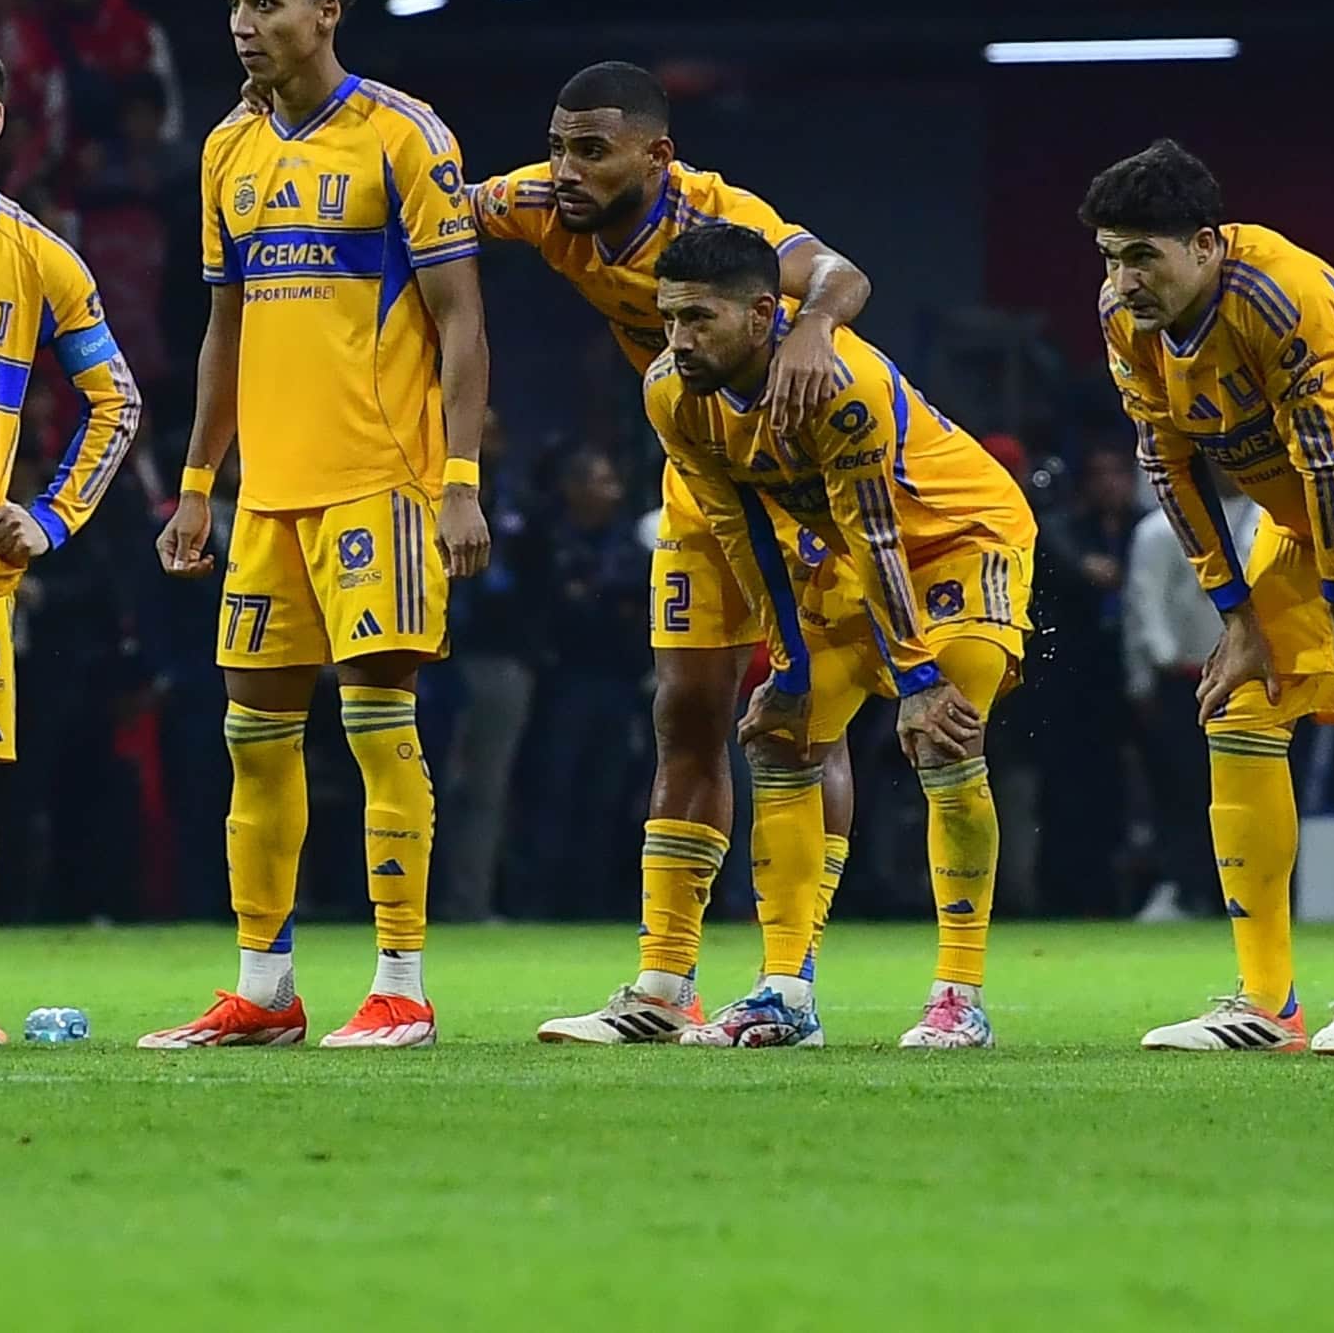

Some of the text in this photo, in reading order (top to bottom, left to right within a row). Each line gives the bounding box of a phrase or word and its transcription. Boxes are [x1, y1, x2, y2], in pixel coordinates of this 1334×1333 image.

[260, 243, 336, 267] CEMEX
[226, 592, 272, 653] 77
[664, 572, 690, 633] 2
